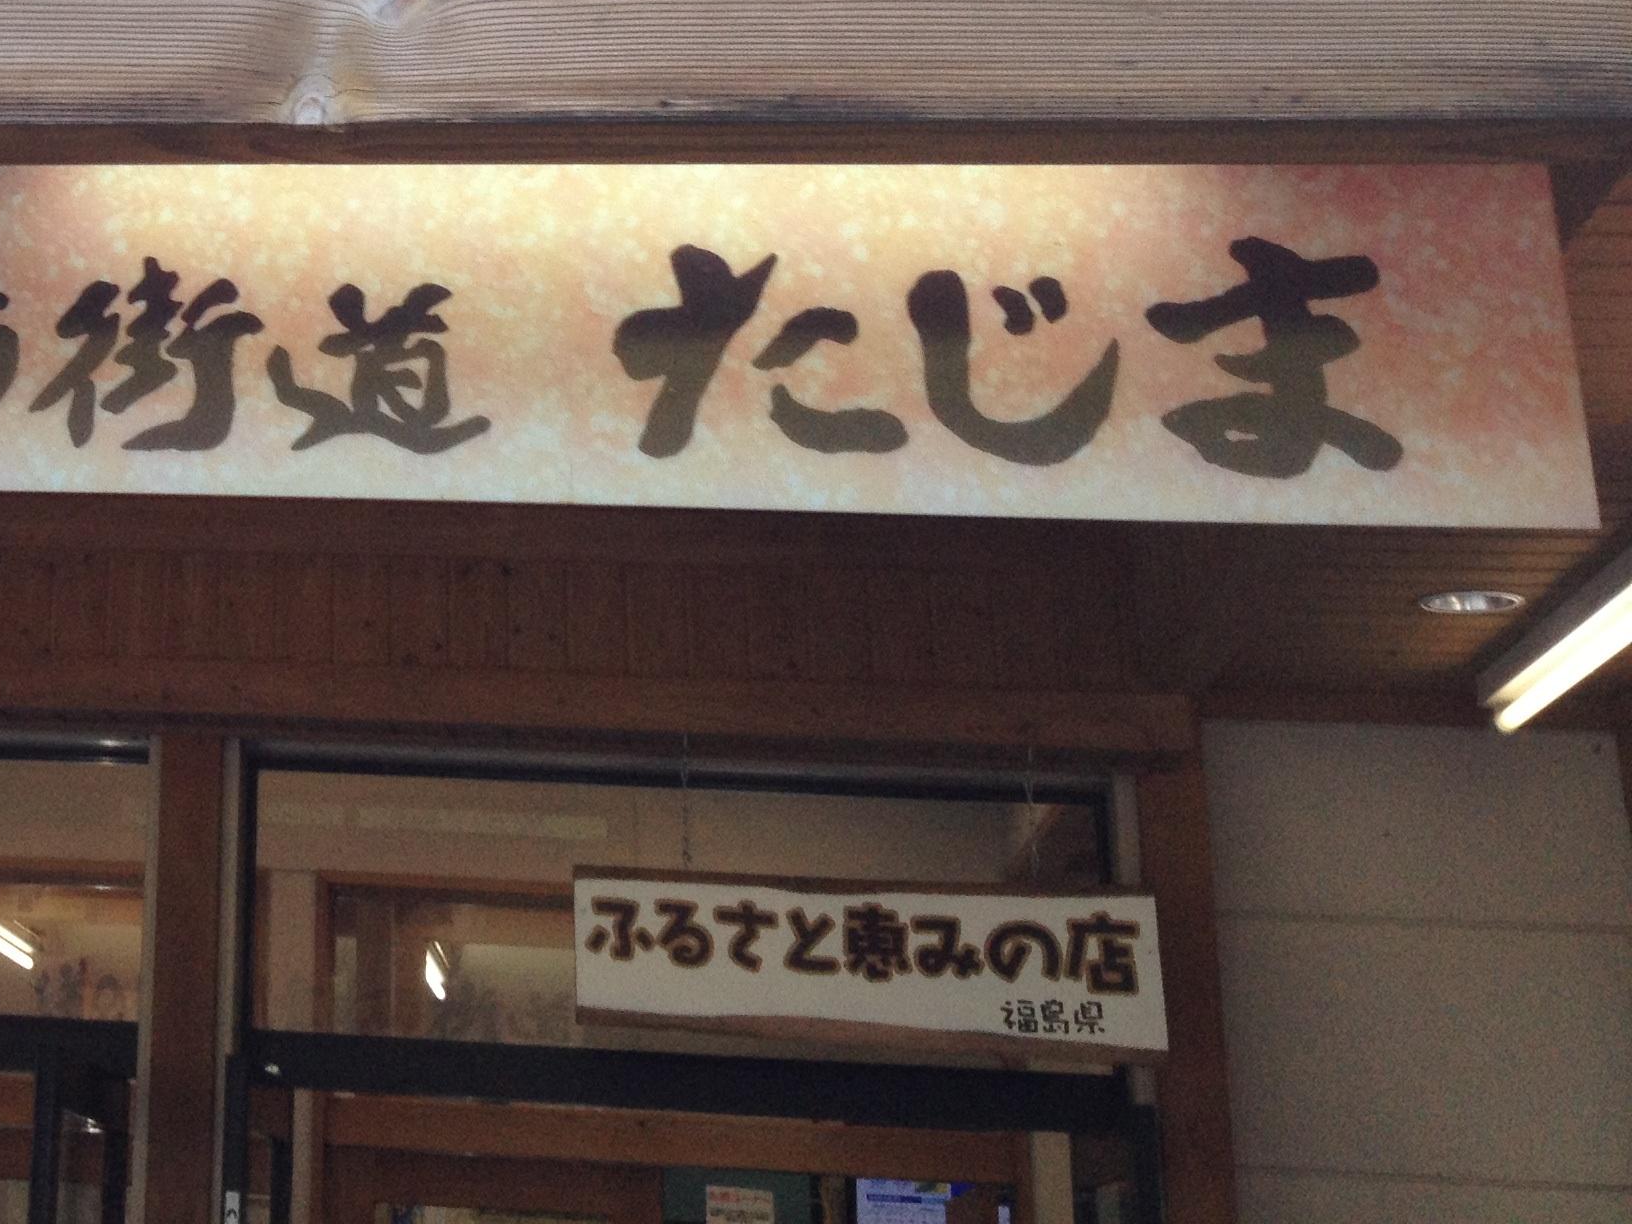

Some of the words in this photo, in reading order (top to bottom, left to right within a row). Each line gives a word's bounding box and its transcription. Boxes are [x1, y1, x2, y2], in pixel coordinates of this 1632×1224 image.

[612, 236, 1404, 480] たじま
[584, 895, 1140, 997] ふるさと恵みの店
[999, 998, 1107, 1036] 福島県
